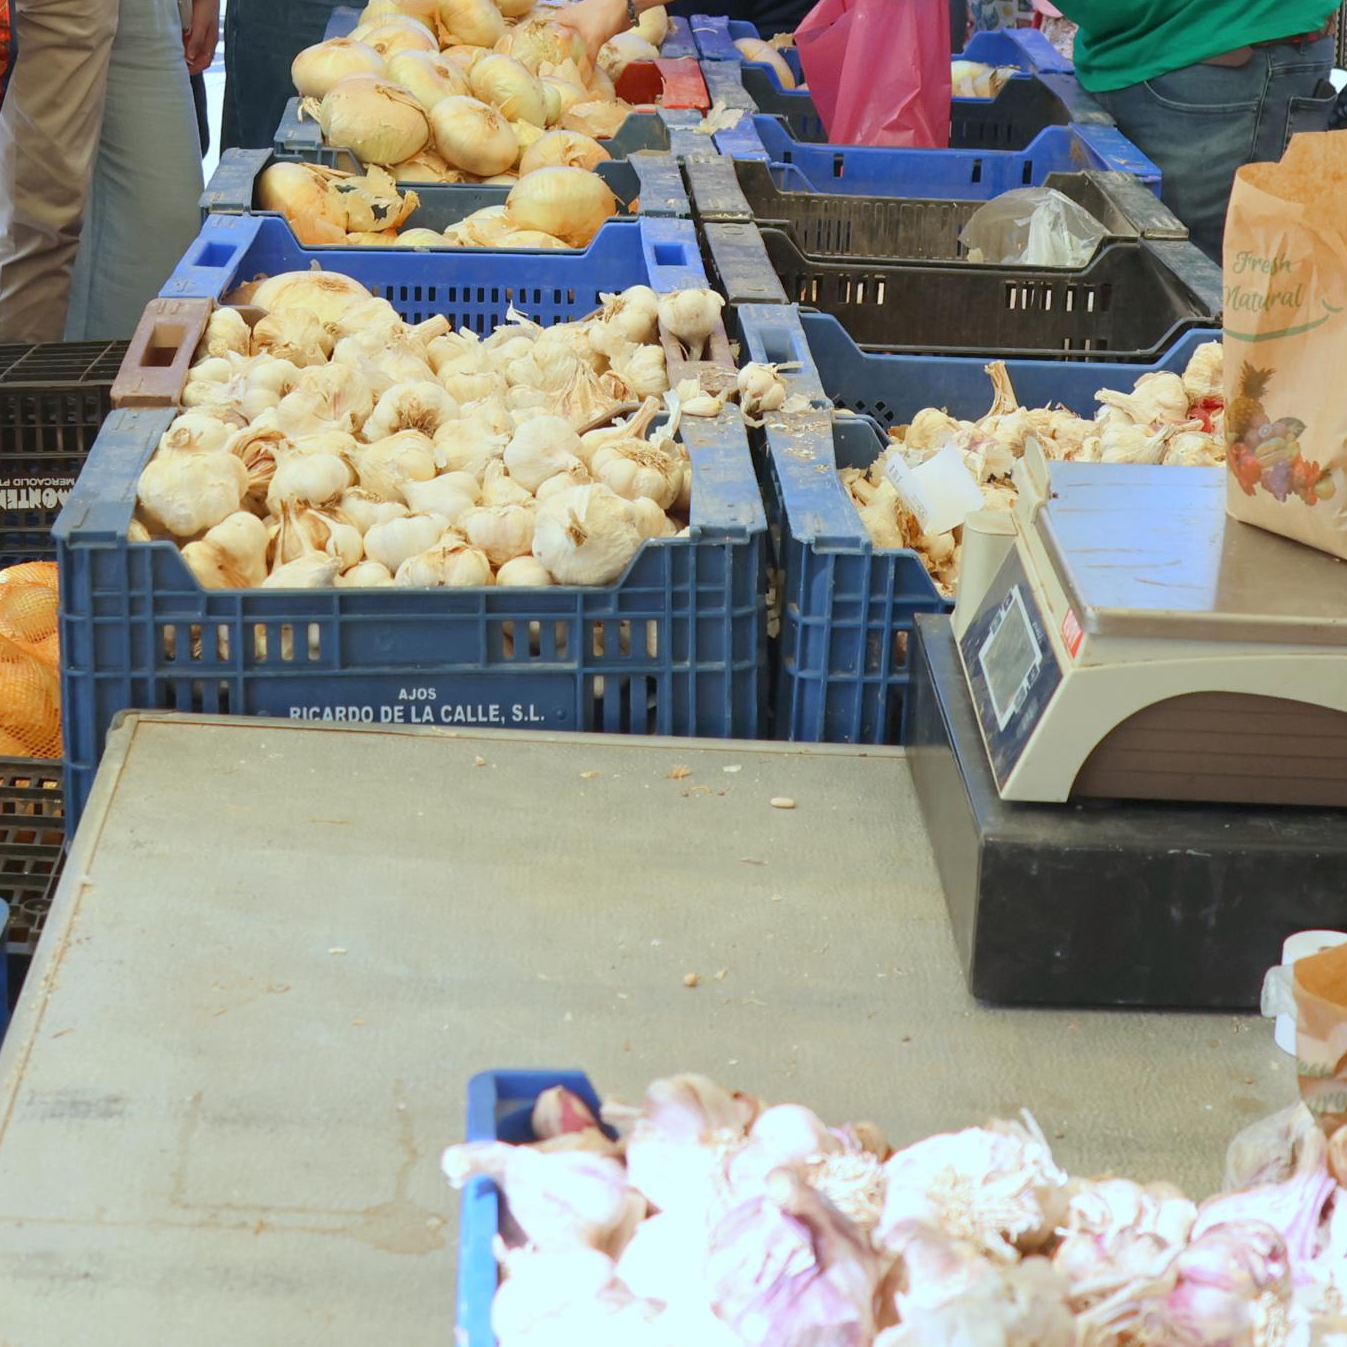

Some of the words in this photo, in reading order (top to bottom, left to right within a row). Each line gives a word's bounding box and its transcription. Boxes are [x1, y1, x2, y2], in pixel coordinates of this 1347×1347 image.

[1233, 251, 1292, 275] Fresh
[1225, 284, 1302, 312] Natural
[398, 688, 437, 700] AJOS
[289, 706, 374, 723] RICARDO
[380, 706, 404, 723] DE
[411, 705, 434, 723] LA
[440, 704, 506, 724] CALLE,
[512, 704, 545, 721] S.L.
